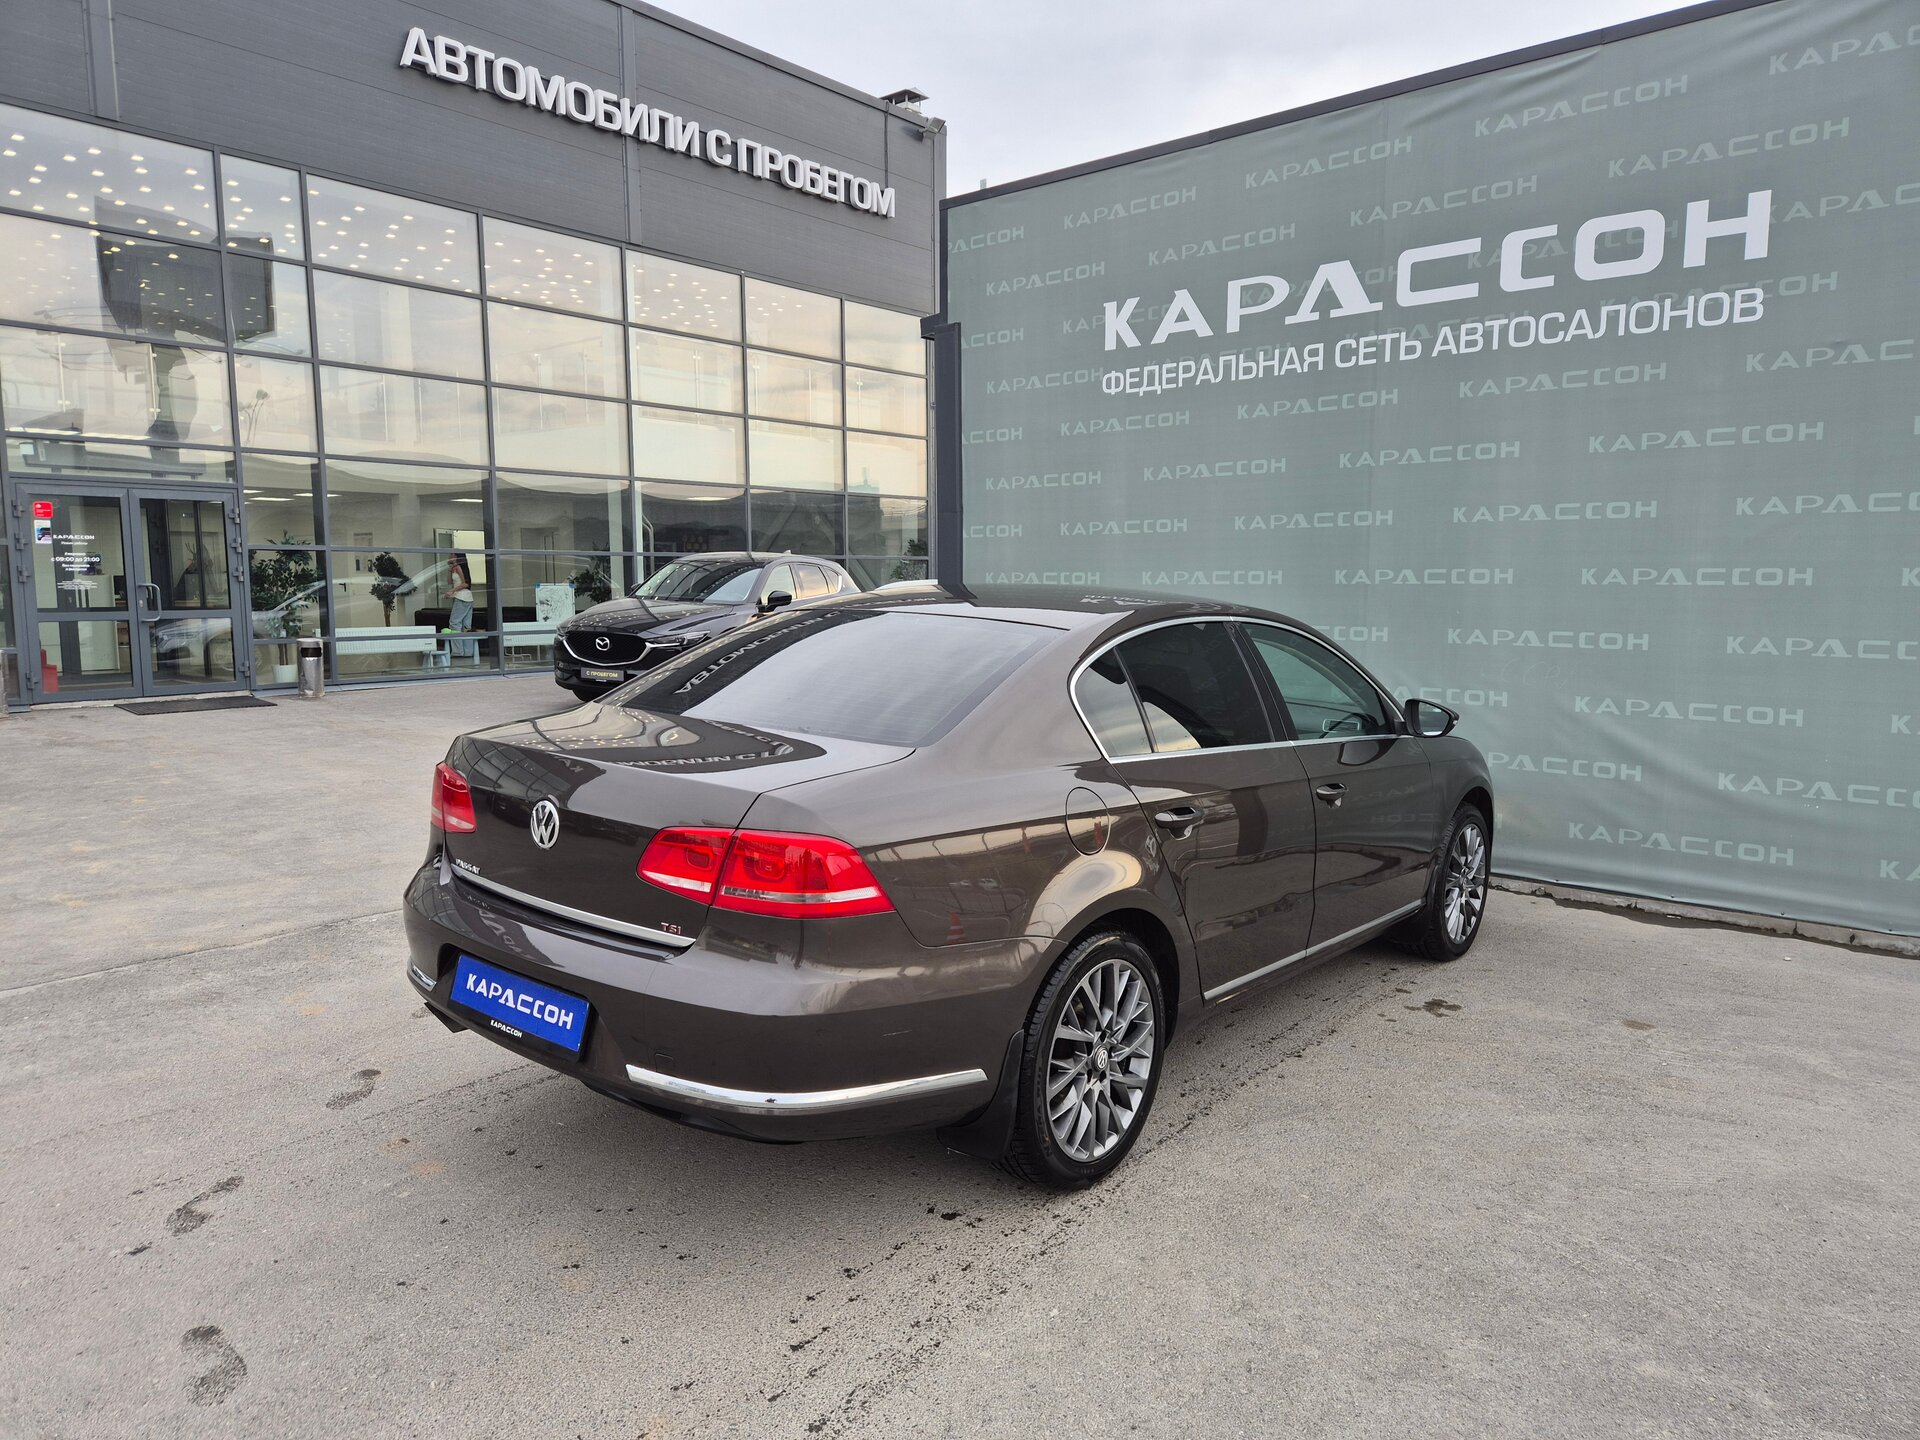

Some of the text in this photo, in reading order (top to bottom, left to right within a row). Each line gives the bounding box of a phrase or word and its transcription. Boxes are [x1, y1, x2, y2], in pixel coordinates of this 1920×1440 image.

[1474, 75, 1688, 137] КАРАССОН
[400, 27, 896, 218] АВТОМОБИЛИ С ПРОБЕГОМ
[1245, 136, 1412, 189] КАРАССОН
[1608, 116, 1850, 178] КАРАССОН
[1063, 186, 1197, 230] КАРАССОН
[1350, 175, 1537, 227] КАРАССОН
[1148, 223, 1296, 267] КАРАССОН
[986, 261, 1105, 296] КАРАССОН
[1103, 190, 1772, 351] КАРАССОН
[1101, 287, 1765, 397] ФЕДЕРАЛЬНАЯ СЕТЬ АВТОСАЛОНОВ
[1459, 362, 1667, 399] КАРАССОН
[1237, 388, 1399, 419] КАРАССОН
[1060, 410, 1190, 437] КАРАССОН
[1588, 421, 1824, 454] КАРАССОН
[1143, 457, 1287, 482] КАРАССОН
[1339, 441, 1521, 469] КАРАССОН
[985, 470, 1102, 490] КАРАССОН
[1060, 518, 1188, 536] КАРАССОН
[1234, 509, 1393, 530] КАРАССОН
[1453, 501, 1657, 523] КАРАССОН
[985, 571, 1101, 585] КАРАССОН
[1142, 570, 1283, 585] КАРАССОН
[1334, 568, 1514, 585] КАРАССОН
[1581, 567, 1814, 586] КАРАССОН
[1447, 628, 1649, 651] КАРАССОН
[1574, 696, 1804, 727] КАРАССОН
[1569, 822, 1794, 866] КАРАССОН
[455, 858, 480, 875] PASSAT
[466, 973, 574, 1030] КАРАССОН
[490, 1019, 523, 1039] КАРАССОН
